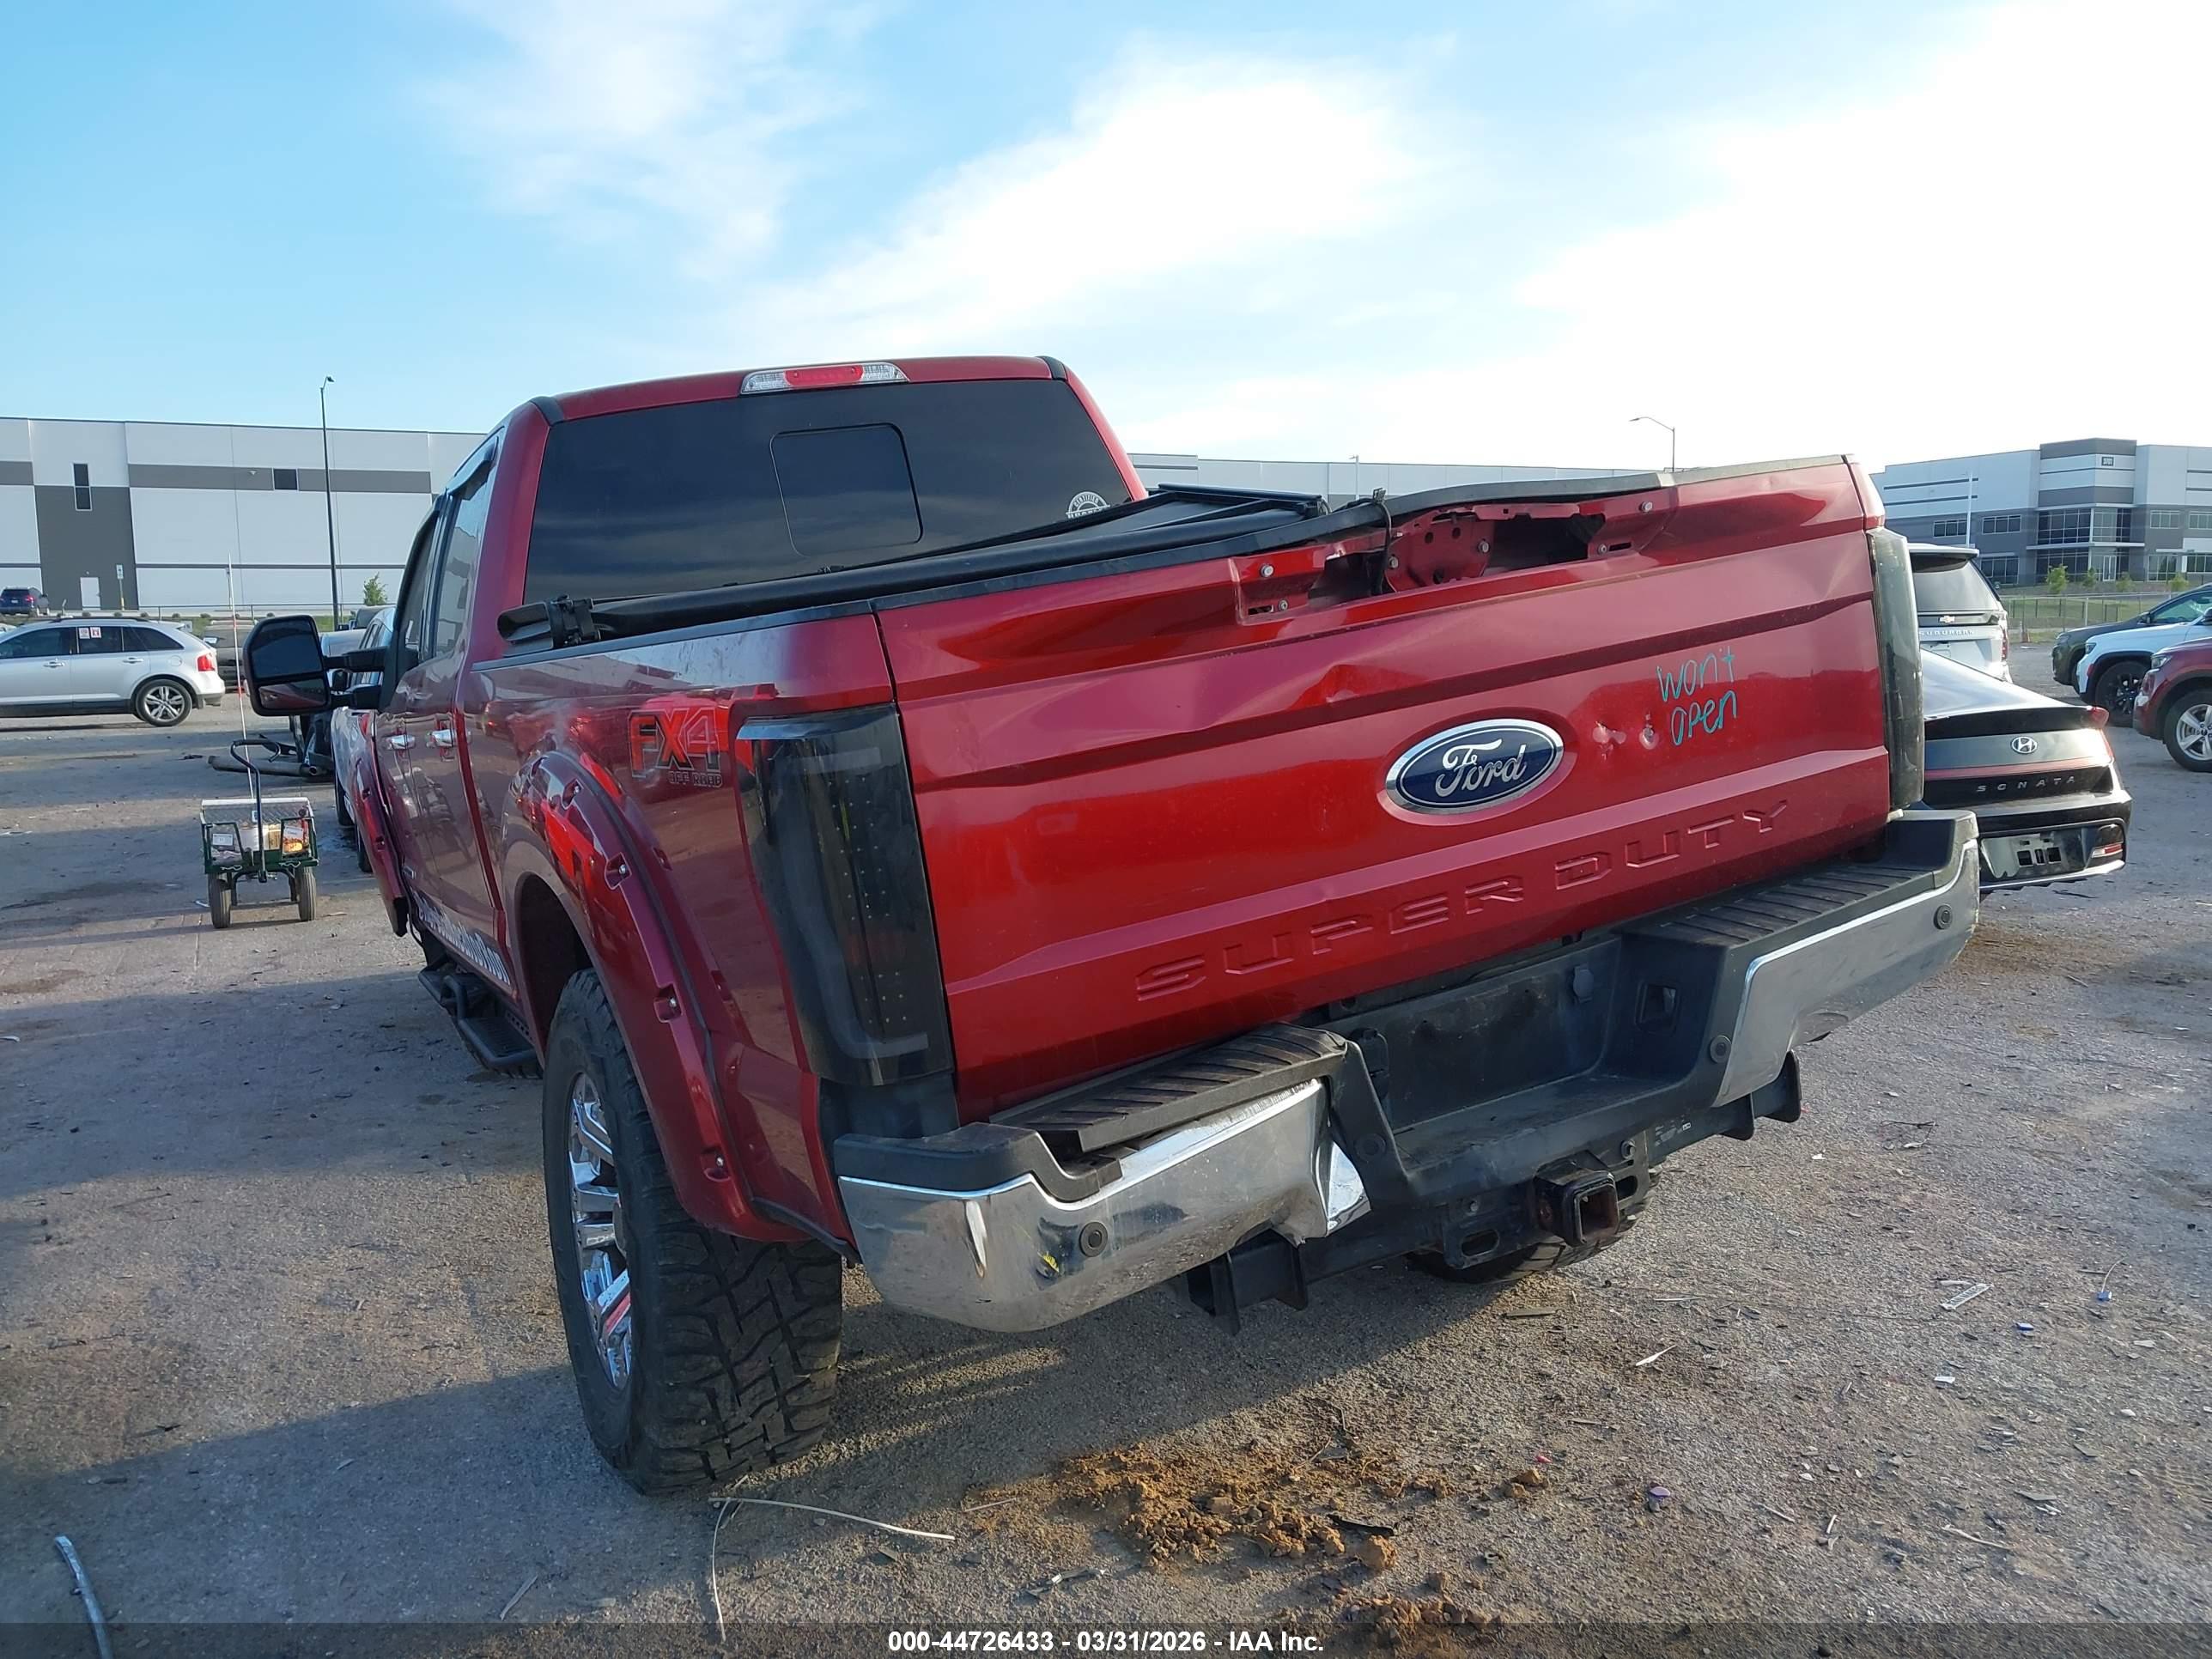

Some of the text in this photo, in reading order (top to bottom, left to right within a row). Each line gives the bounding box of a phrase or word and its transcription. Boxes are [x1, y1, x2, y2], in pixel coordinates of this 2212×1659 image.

[628, 707, 721, 778] FX4
[1435, 738, 1527, 797] Ford
[692, 773, 723, 787] ROAD
[1977, 776, 2075, 792] SONATA
[1136, 799, 1788, 1001] SUPER DUTY
